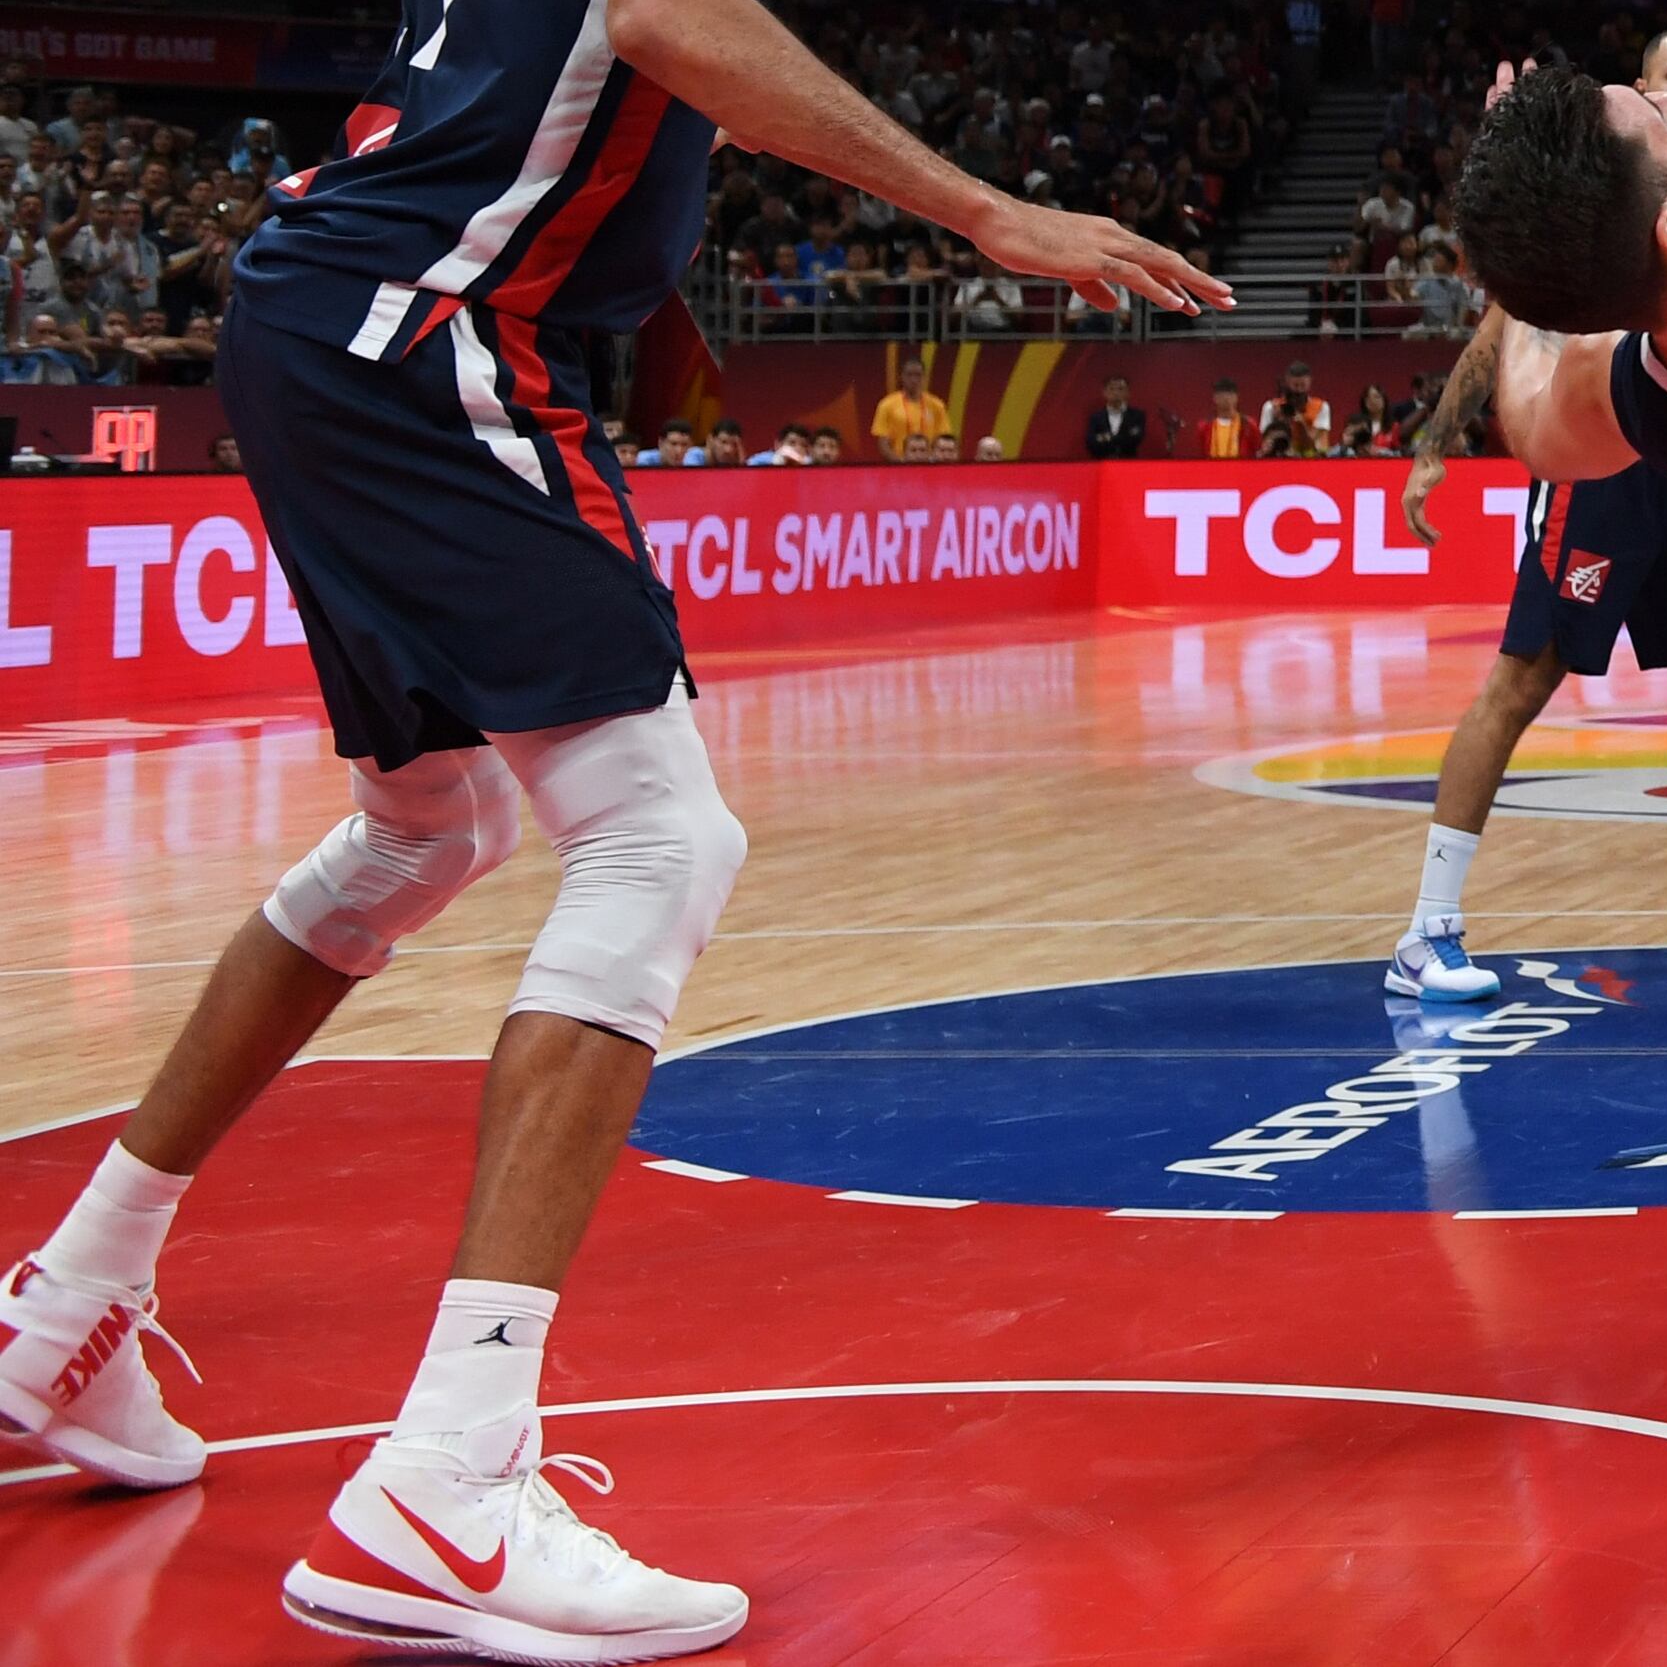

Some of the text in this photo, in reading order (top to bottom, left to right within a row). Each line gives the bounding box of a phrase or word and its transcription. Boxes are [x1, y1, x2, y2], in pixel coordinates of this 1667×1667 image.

[645, 501, 1080, 600] TCL SMART AIRCON
[1144, 484, 1431, 578] TCL
[1163, 1001, 1605, 1182] AEROFLOT
[51, 1303, 133, 1407] NIKE
